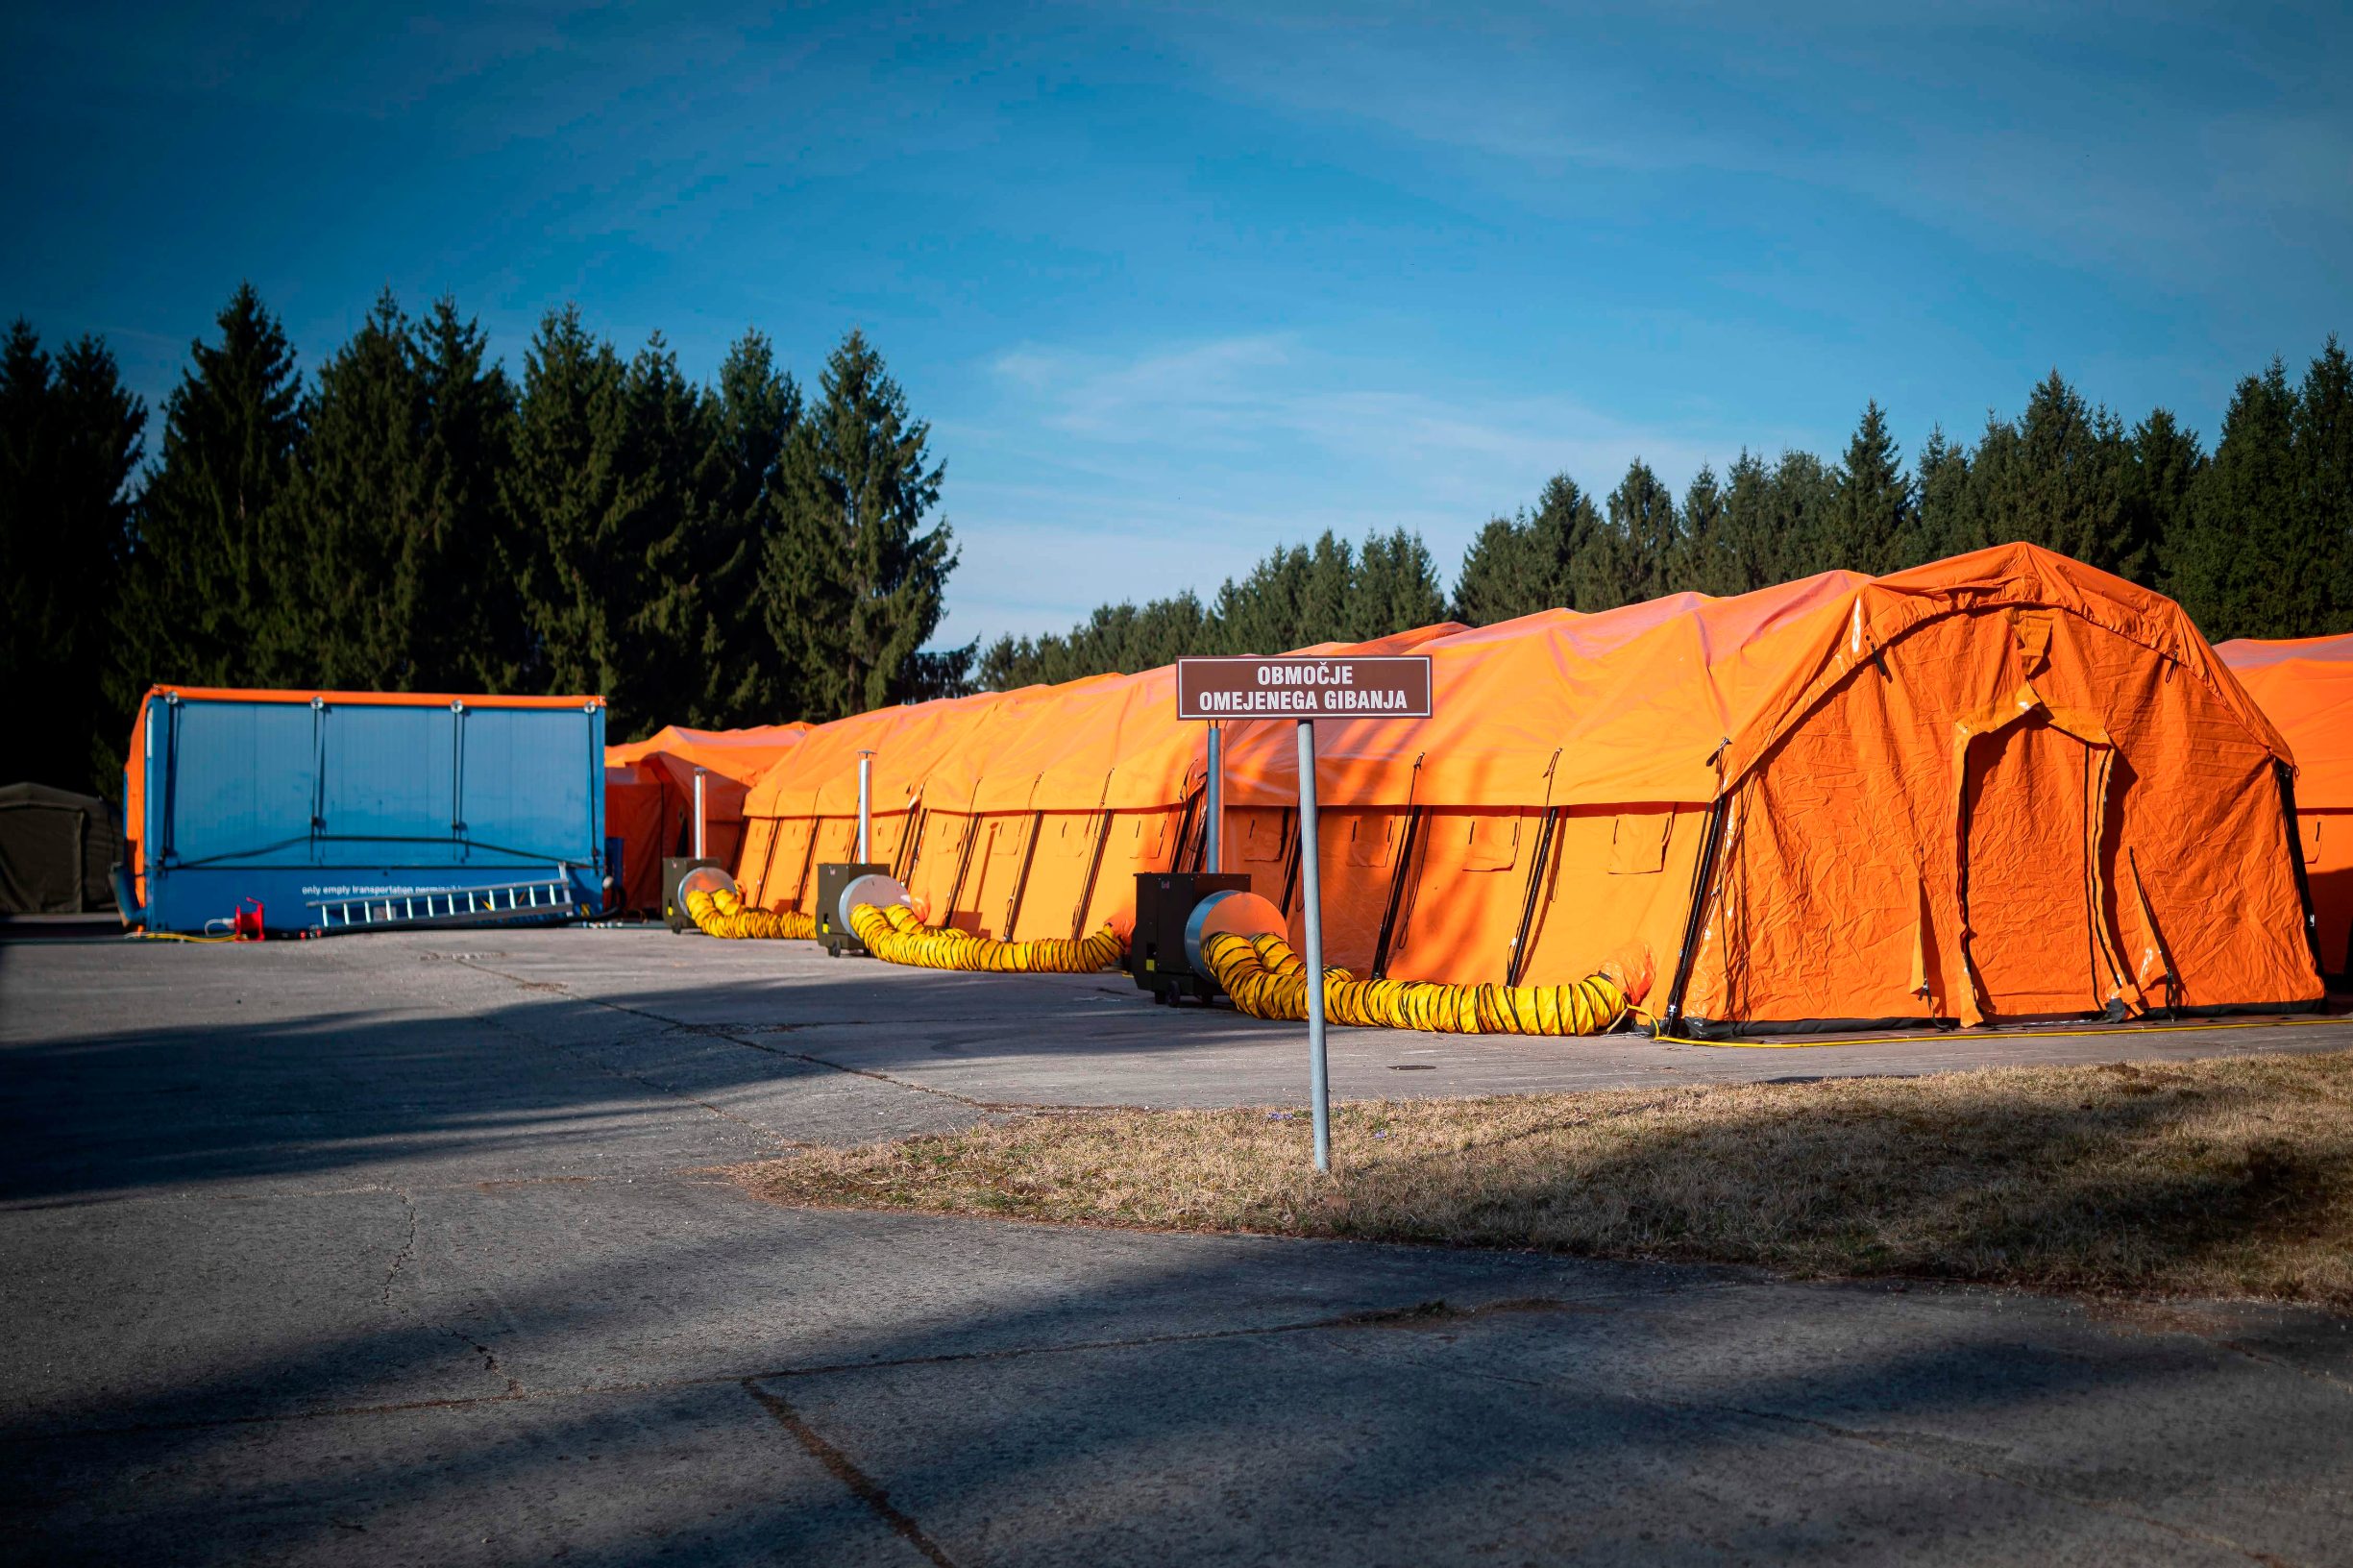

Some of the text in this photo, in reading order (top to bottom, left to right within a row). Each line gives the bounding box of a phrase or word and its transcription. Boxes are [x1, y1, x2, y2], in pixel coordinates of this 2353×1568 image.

[1257, 661, 1353, 685] OBMOČJE
[1199, 689, 1408, 711] OMEJENEGA GIBANJA
[302, 885, 321, 896] only
[322, 885, 351, 896] empty
[352, 885, 414, 896] transportation
